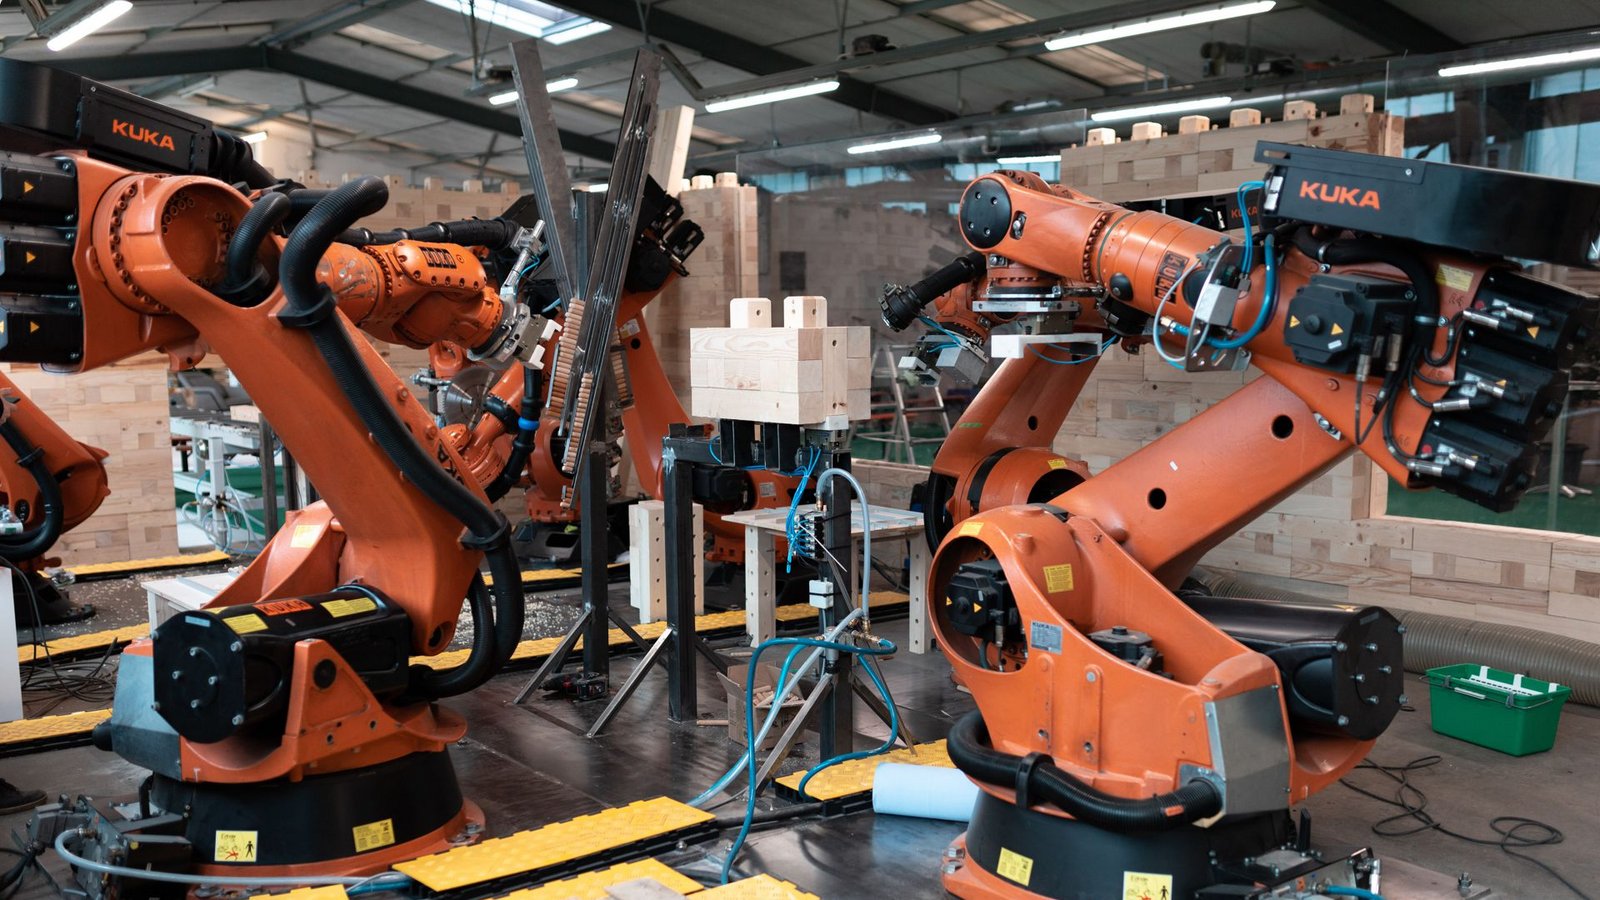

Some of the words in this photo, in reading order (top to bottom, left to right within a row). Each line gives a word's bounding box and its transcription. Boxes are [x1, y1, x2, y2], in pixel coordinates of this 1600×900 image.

[113, 119, 175, 151] KUKA
[1299, 180, 1380, 210] KUKA
[1231, 206, 1258, 219] KA
[260, 600, 309, 613] KUKA
